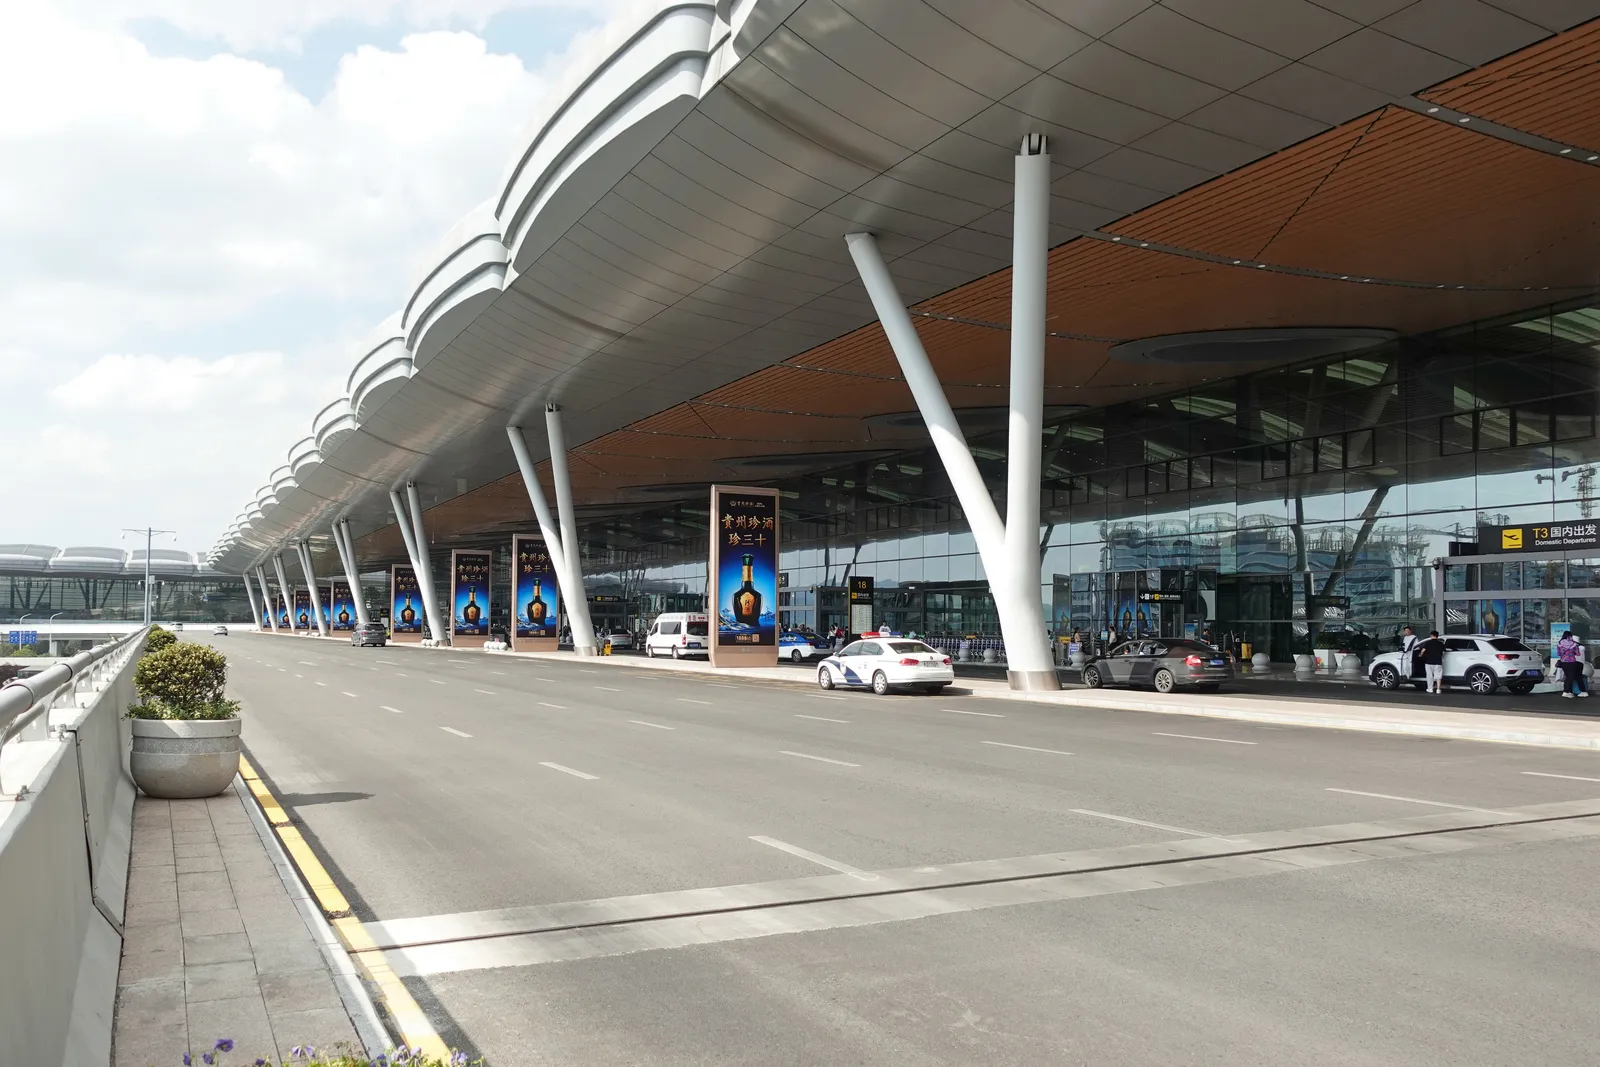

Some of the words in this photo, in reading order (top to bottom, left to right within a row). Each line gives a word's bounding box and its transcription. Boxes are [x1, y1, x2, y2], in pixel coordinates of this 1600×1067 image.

[1551, 523, 1597, 538] 国内出发
[728, 532, 767, 547] 珍三十
[1563, 537, 1597, 545] Departures
[857, 580, 867, 589] 18
